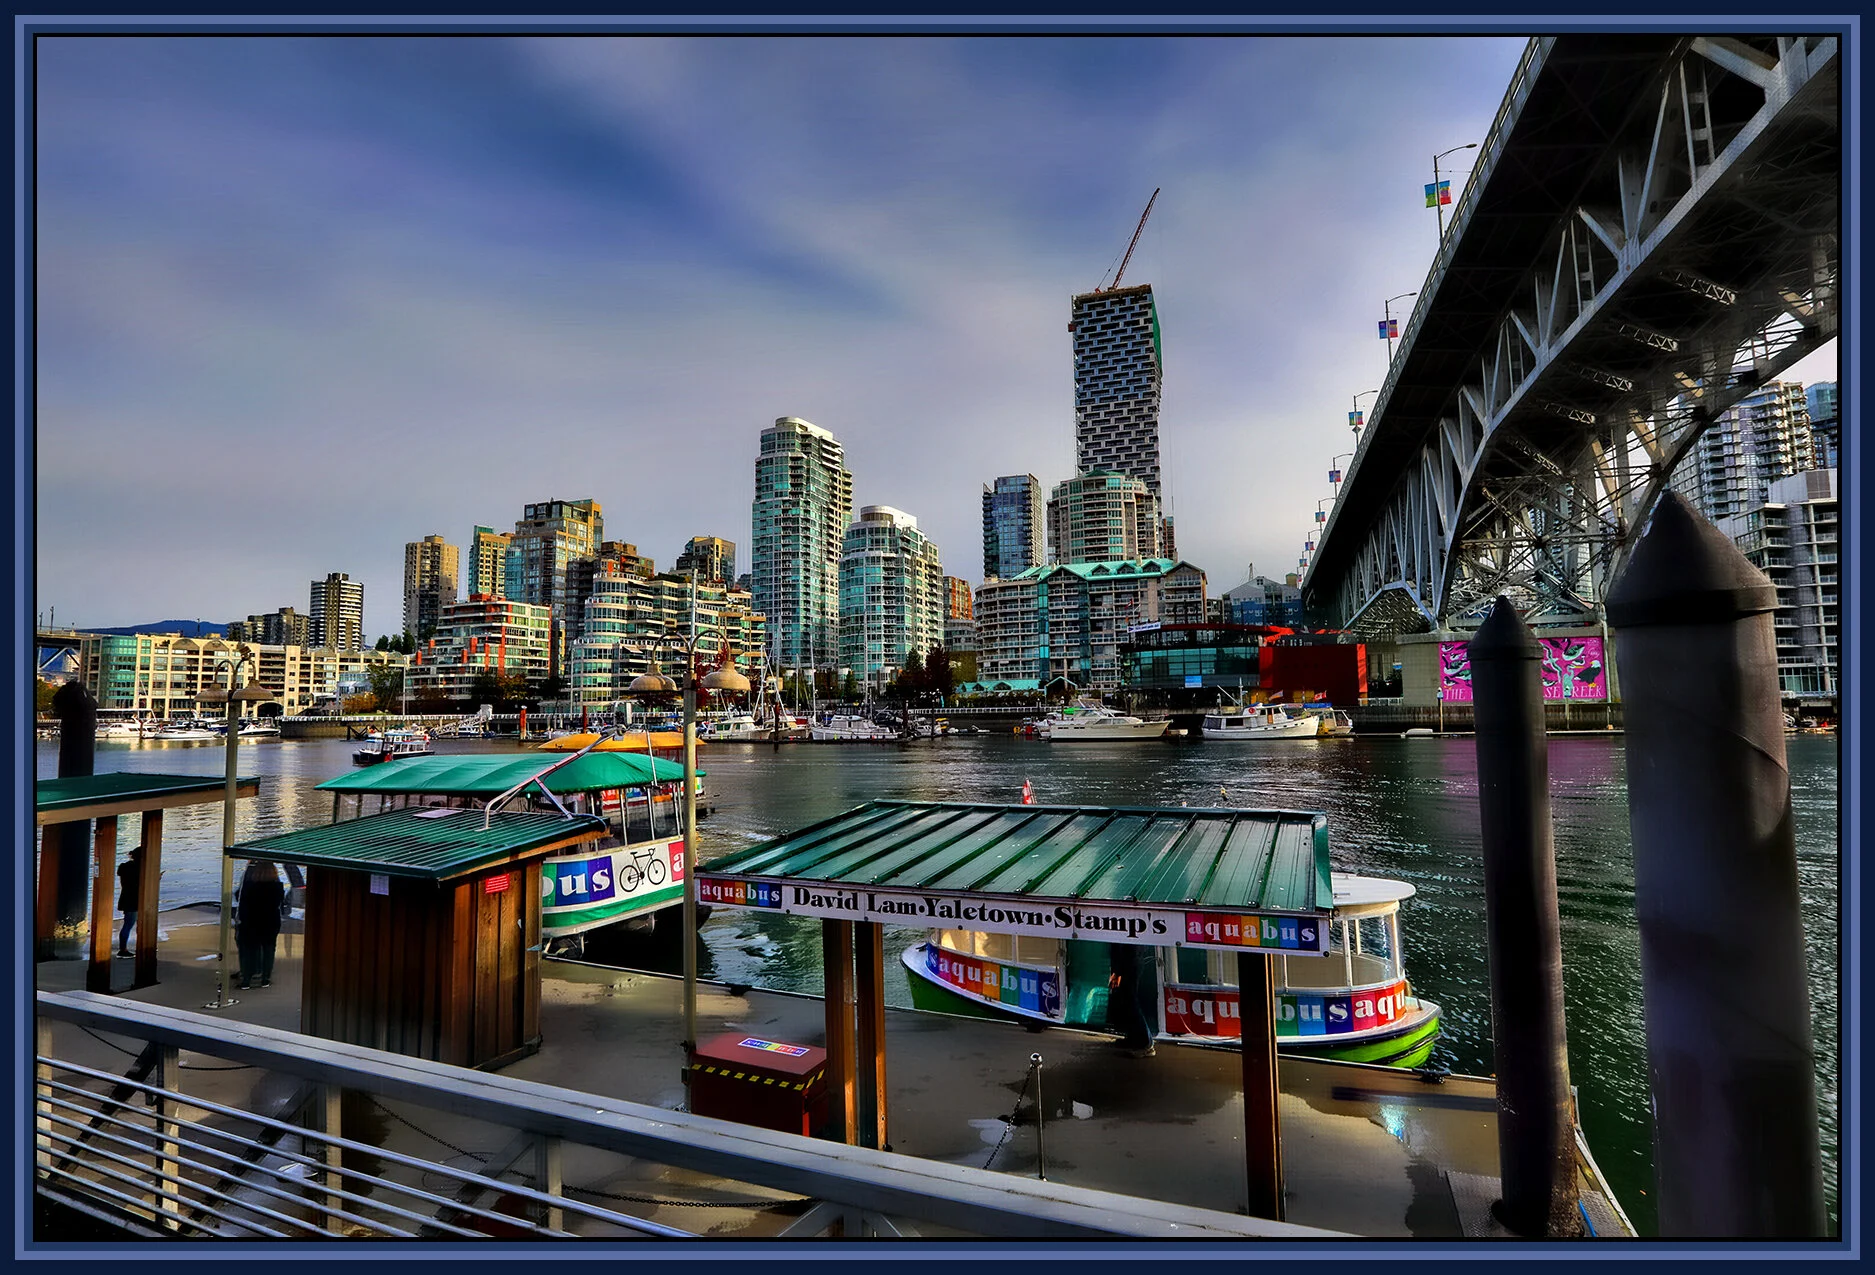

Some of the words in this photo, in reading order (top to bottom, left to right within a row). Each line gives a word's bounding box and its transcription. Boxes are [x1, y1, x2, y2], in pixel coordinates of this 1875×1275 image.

[1445, 688, 1466, 700] THE
[1543, 686, 1561, 698] SE
[1572, 685, 1604, 698] REEK
[701, 884, 780, 902] aquabus
[793, 887, 859, 911] David
[1188, 917, 1316, 943] aquabus
[939, 957, 1057, 998] aquabus
